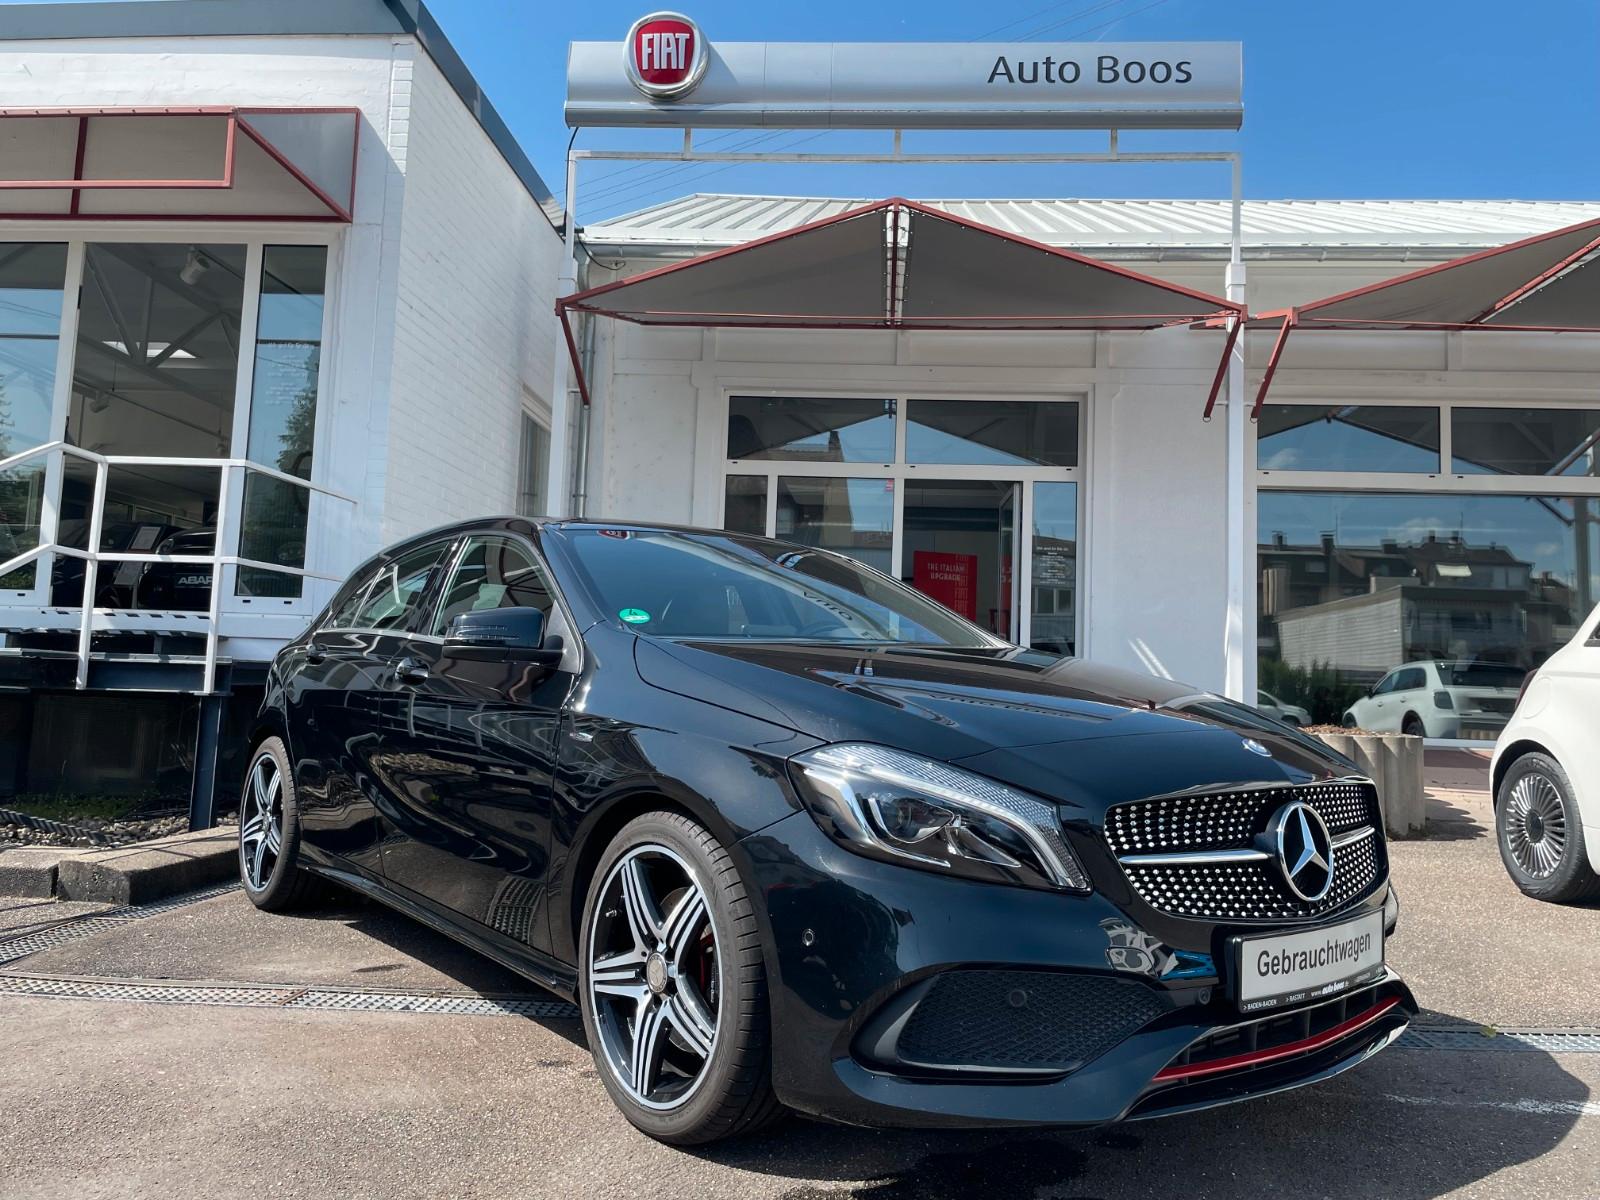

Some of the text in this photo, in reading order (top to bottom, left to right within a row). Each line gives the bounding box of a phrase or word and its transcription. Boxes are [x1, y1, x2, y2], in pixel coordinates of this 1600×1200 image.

[641, 33, 690, 70] FIAT
[987, 55, 1193, 84] Auto Boos
[927, 562, 938, 571] THE
[1257, 932, 1371, 977] Gebrauchtwagen
